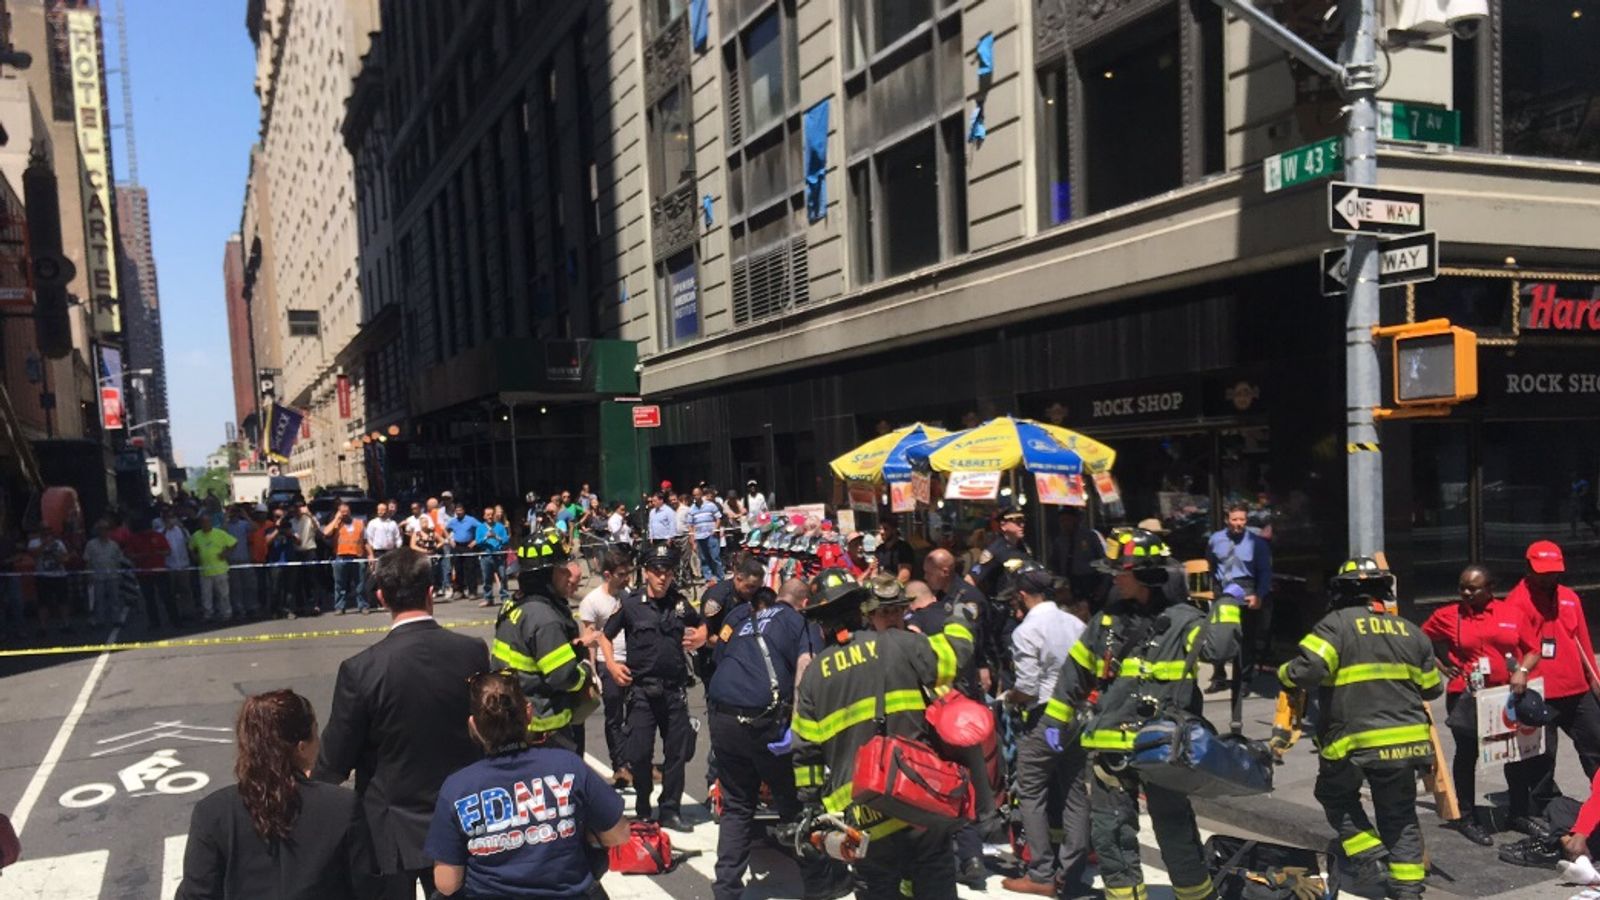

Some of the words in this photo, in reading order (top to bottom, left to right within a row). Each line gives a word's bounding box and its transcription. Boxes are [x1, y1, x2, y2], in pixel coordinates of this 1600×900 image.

[75, 31, 99, 154] HOTEL
[1410, 111, 1420, 136] 7
[1283, 154, 1299, 182] W
[1304, 146, 1324, 175] 43
[1346, 199, 1374, 220] ONE
[1385, 203, 1415, 223] WAY
[87, 170, 114, 316] CARTER
[1381, 249, 1420, 272] WAY
[1506, 373, 1564, 393] ROCK
[1092, 397, 1134, 418] ROCK
[1137, 392, 1184, 413] SHOP
